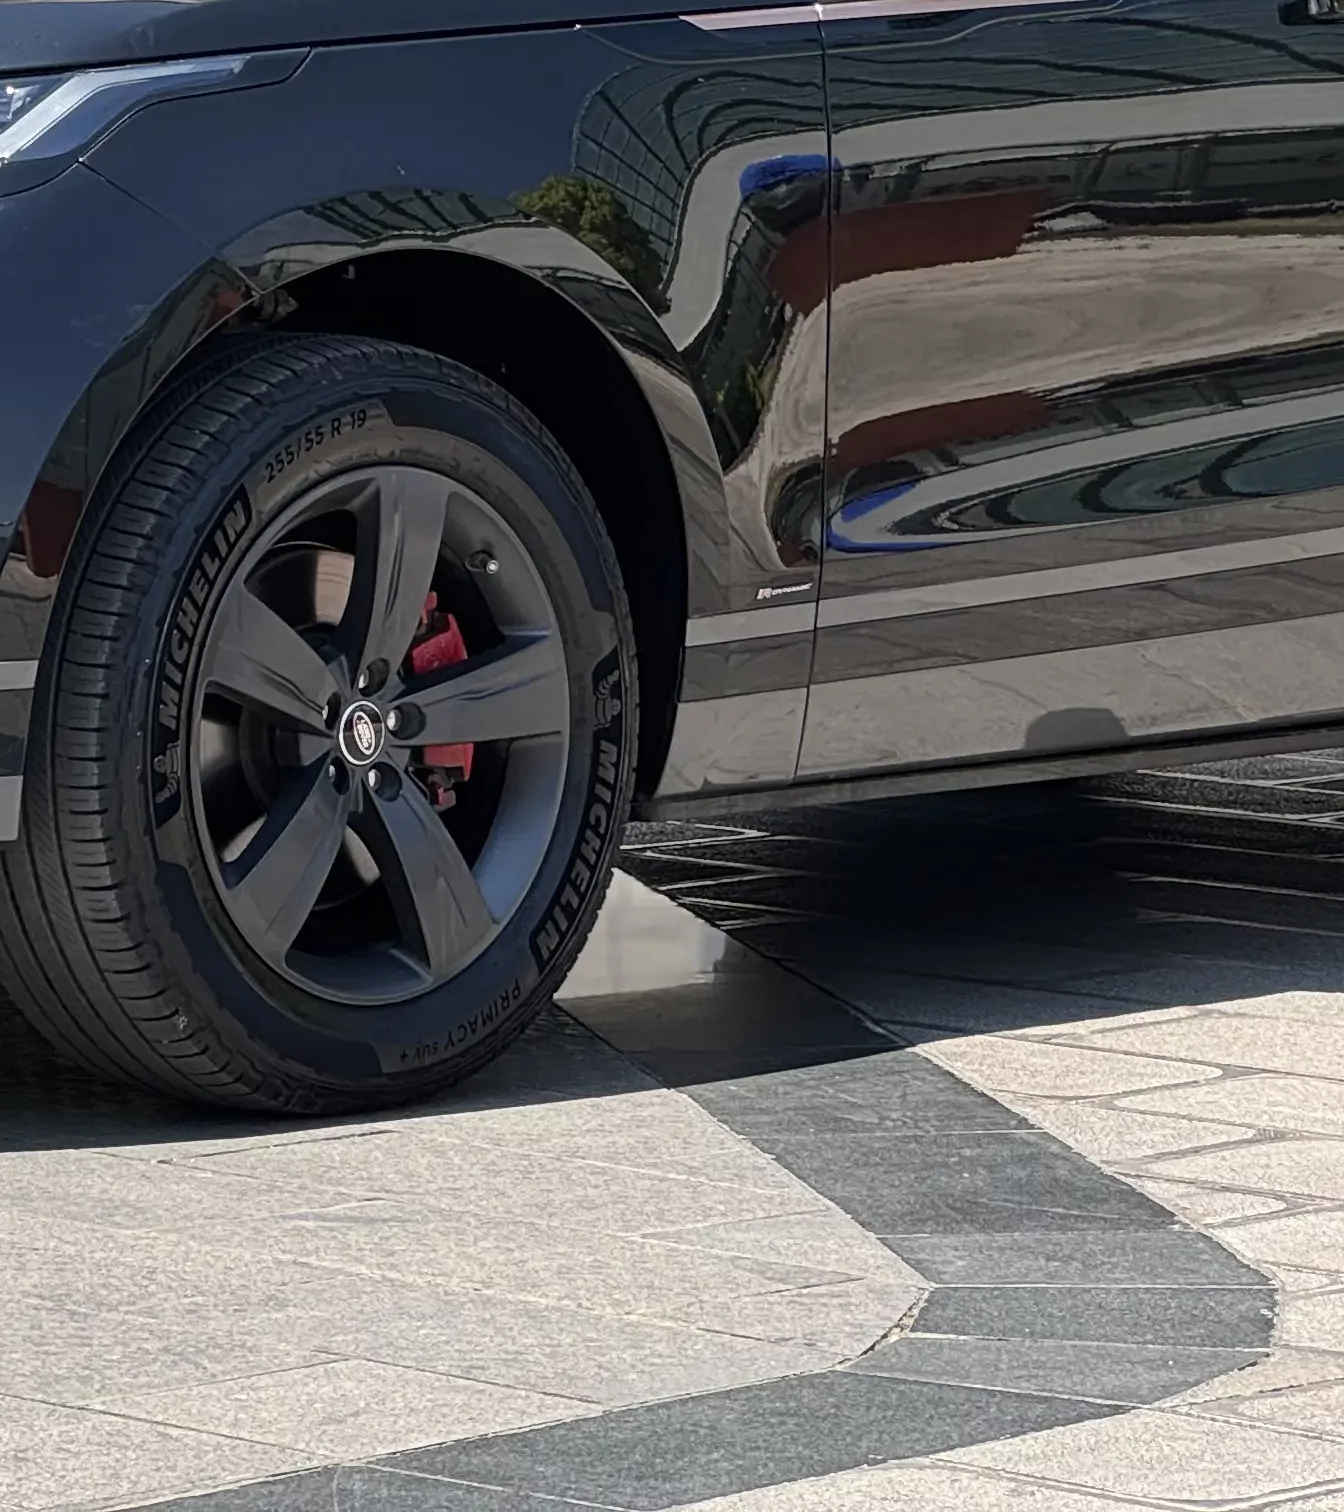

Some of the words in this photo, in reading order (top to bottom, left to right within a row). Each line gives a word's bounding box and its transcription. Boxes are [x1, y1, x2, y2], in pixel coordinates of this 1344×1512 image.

[264, 425, 324, 484] 255/55
[330, 417, 342, 439] R
[158, 500, 248, 732] MICHELIN
[535, 740, 619, 961] MICHELIN
[444, 978, 522, 1051] PRIMACY
